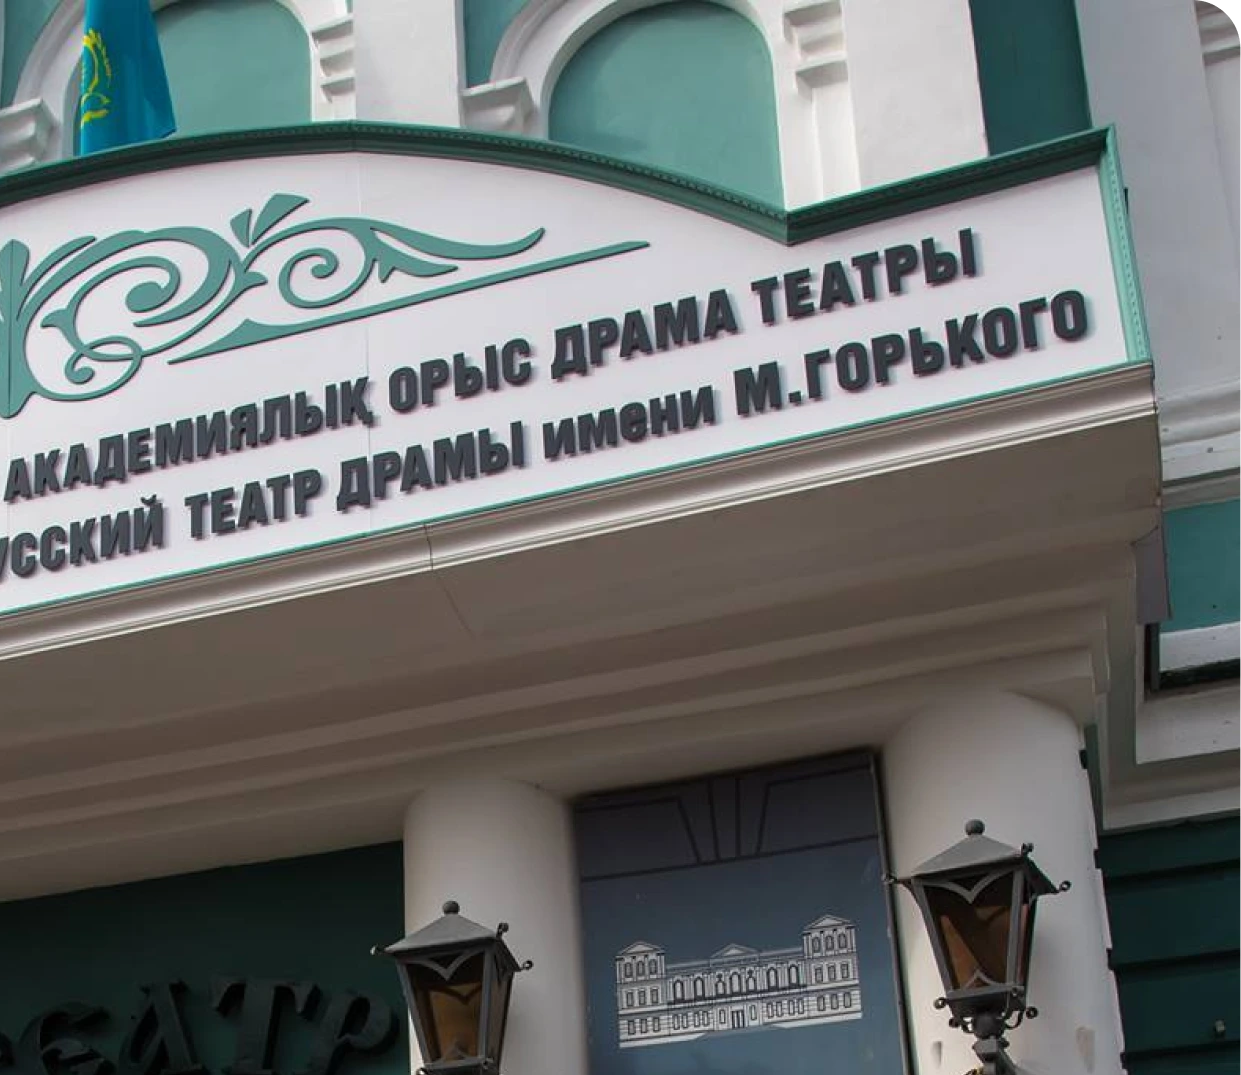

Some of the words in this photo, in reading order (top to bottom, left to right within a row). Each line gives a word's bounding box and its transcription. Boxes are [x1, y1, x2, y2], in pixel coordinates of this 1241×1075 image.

[4, 375, 375, 503] АКАДЕМИЯЛЫҚ
[387, 338, 534, 412] ОРЫС
[550, 288, 740, 382] ДРАМА
[750, 228, 978, 326] ТЕАТРЫ
[184, 467, 324, 540] ТЕАТР
[335, 420, 526, 513] ДРАМЫ
[541, 384, 716, 462] имени
[732, 288, 1090, 417] М.ГОРЬКОГО
